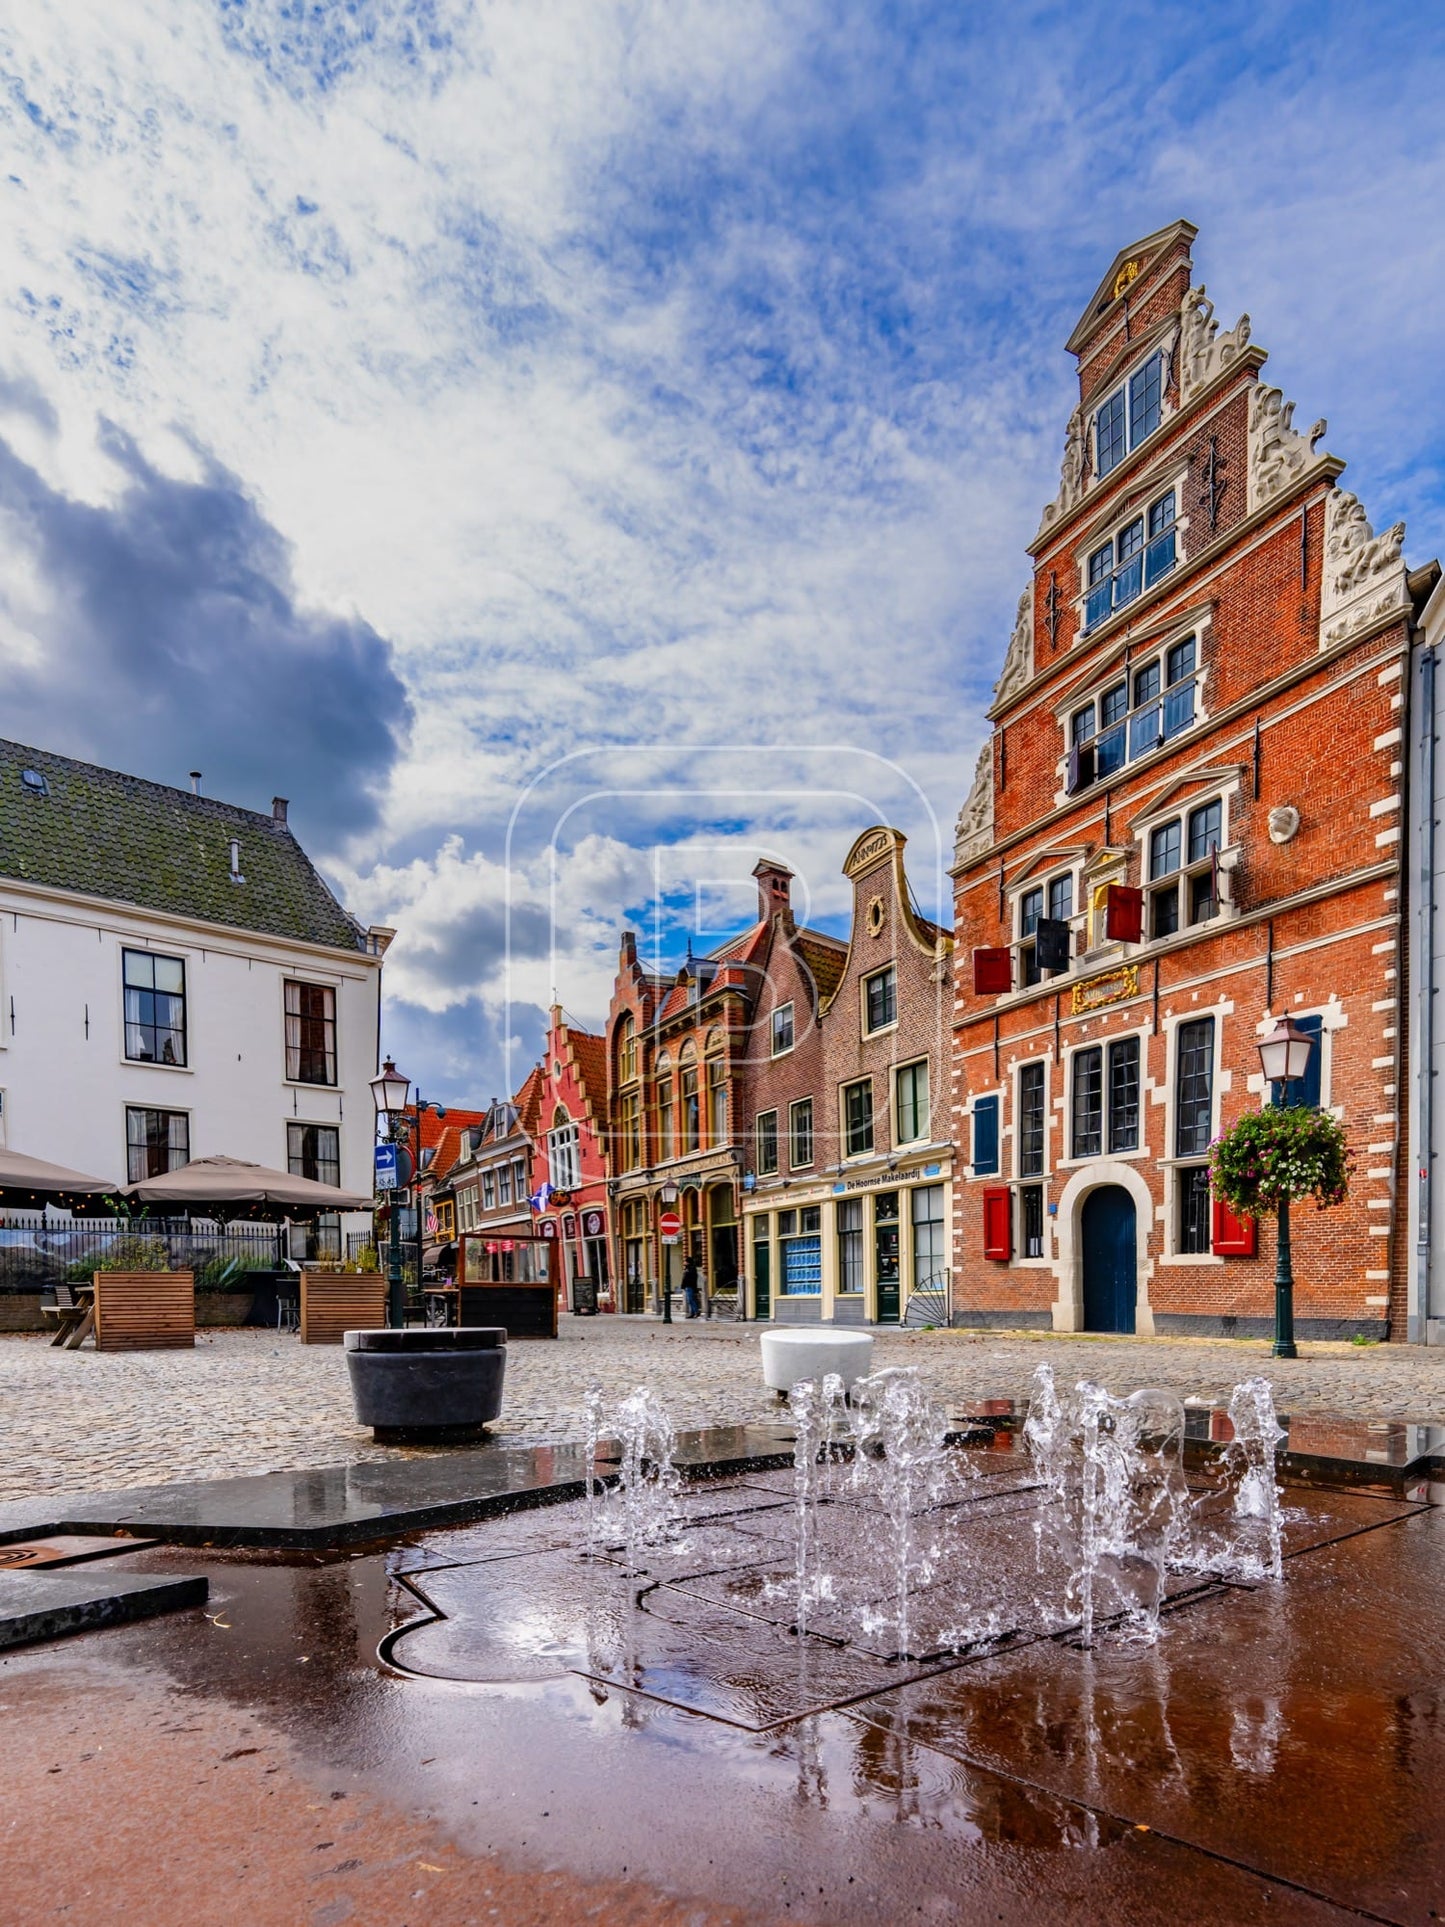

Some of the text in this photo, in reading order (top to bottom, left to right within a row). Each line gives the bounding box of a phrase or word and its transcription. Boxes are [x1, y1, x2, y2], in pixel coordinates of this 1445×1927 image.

[847, 1181, 855, 1190] De
[855, 1177, 881, 1188] Hoornse
[881, 1169, 920, 1182] Makelaardij
